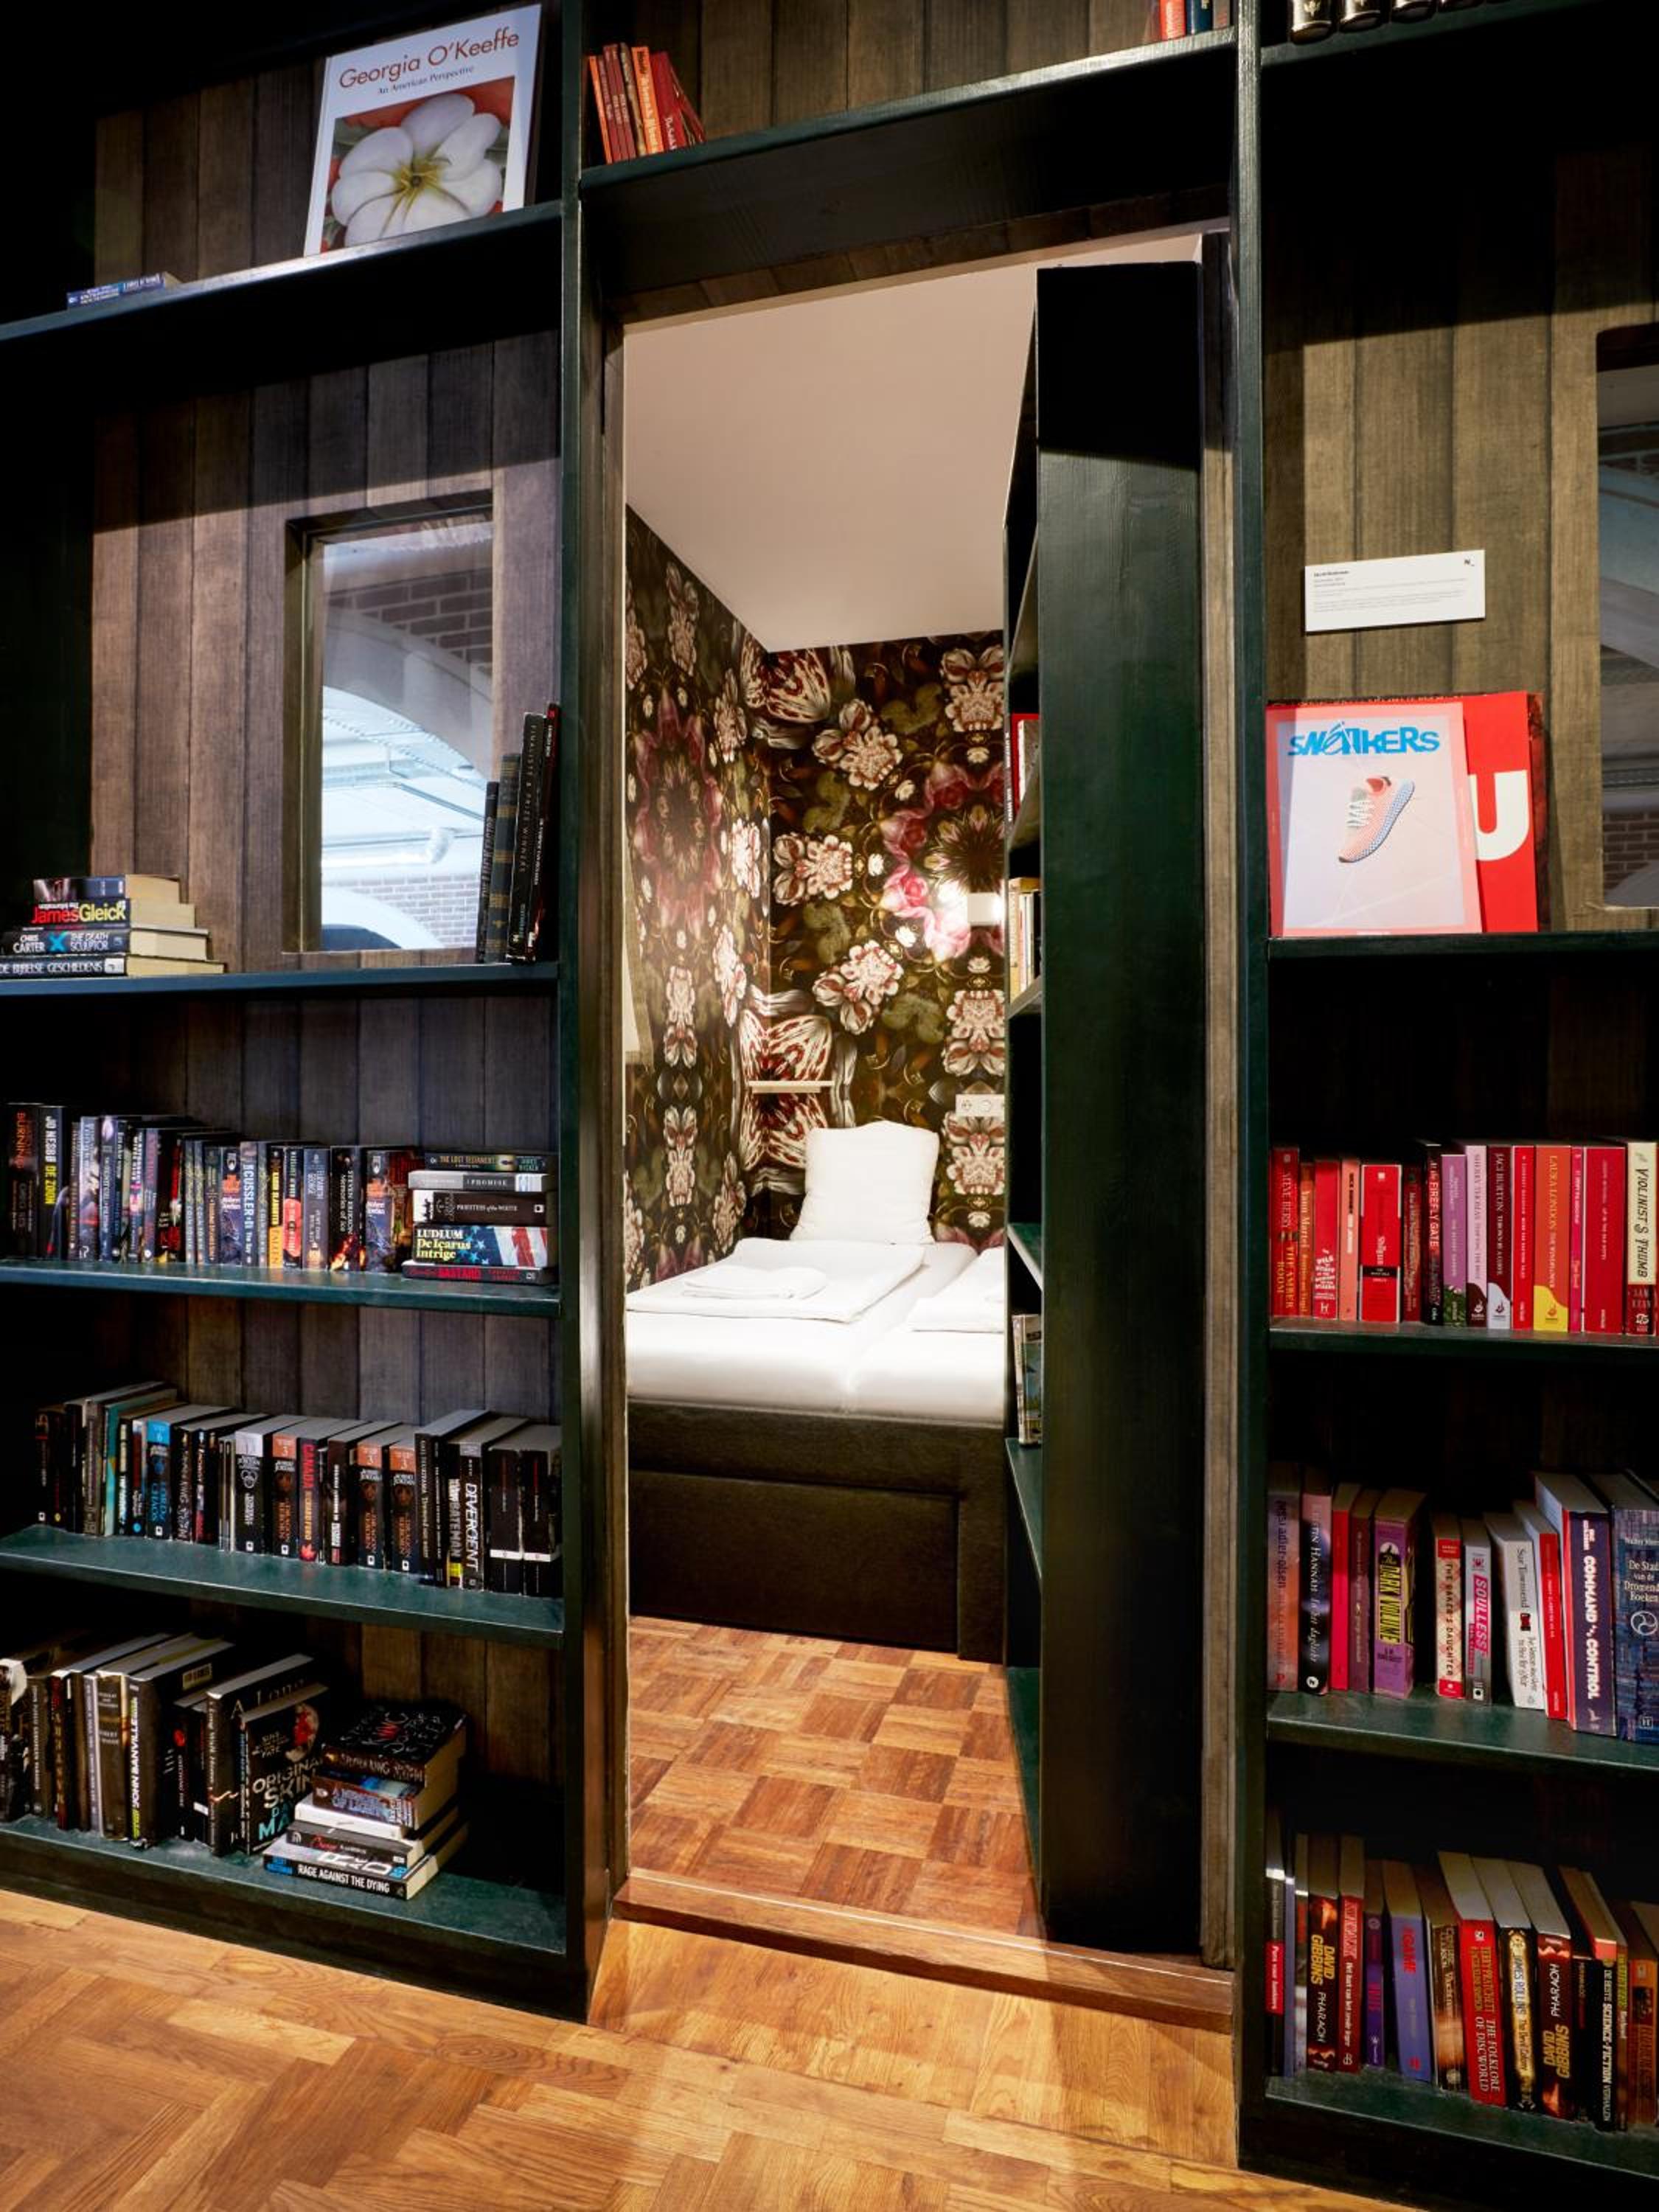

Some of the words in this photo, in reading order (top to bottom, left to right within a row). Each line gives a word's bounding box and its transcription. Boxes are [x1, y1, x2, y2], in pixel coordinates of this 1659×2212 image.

[339, 55, 420, 88] Georgia
[428, 27, 520, 66] O'Keeffe
[392, 78, 428, 92] American
[429, 66, 475, 83] Perspective
[31, 905, 80, 924] James
[80, 901, 127, 922] Gleick
[13, 942, 45, 953] CARTER
[21, 935, 39, 943] CHRIS
[71, 933, 84, 942] THE
[86, 933, 108, 942] DEATH
[71, 941, 109, 951] SCULPTOR
[45, 1116, 57, 1129] JO
[45, 1164, 57, 1178] DE
[1548, 1156, 1558, 1188] LAURA
[45, 1179, 57, 1204] ZOON
[243, 1171, 254, 1216] CUSSLER
[1301, 1190, 1310, 1213] Yann
[1429, 1182, 1439, 1220] FIREFLY
[1495, 1175, 1505, 1211] BURTON
[340, 1211, 347, 1220] of
[1548, 1189, 1558, 1229] LONDON
[417, 1229, 464, 1239] LUDLUM
[417, 1239, 433, 1249] De
[434, 1239, 472, 1251] Icarus
[1301, 1215, 1310, 1248] Martel
[1429, 1222, 1439, 1247] GATE
[417, 1248, 456, 1260] Intrige
[1276, 1262, 1285, 1294] ROOM
[1286, 1271, 1295, 1308] AMBER
[302, 1444, 314, 1488] CANADA
[449, 1501, 462, 1557] BATEMAN
[465, 1483, 479, 1573] DIVERGENT
[1277, 1528, 1288, 1589] adler-olsen
[1310, 1547, 1322, 1593] HANNAH
[1516, 1548, 1527, 1564] Sue
[1629, 1559, 1640, 1570] De
[1379, 1565, 1402, 1594] DARK
[1518, 1566, 1531, 1608] Townsend
[1583, 1555, 1597, 1623] COMMAND
[1379, 1598, 1402, 1644] VOLUME
[1475, 1578, 1488, 1652] SOULLESS
[1446, 1627, 1454, 1676] DAUGHTER
[1586, 1638, 1601, 1700] CONTROL
[130, 1719, 139, 1775] BANVILLE
[298, 1864, 318, 1877] RAGE
[319, 1867, 350, 1885] AGAINST
[350, 1875, 365, 1888] THE
[366, 1879, 391, 1893] DYING
[1310, 1934, 1324, 1986] GIBBINS
[1324, 1946, 1335, 1980] DAVID
[1512, 1954, 1523, 1979] JAMES
[1514, 1981, 1525, 2016] ROLLINS
[1548, 1963, 1561, 2017] PHARAOH
[1316, 1992, 1329, 2043] PHARAOH
[1475, 2017, 1485, 2031] OF
[1486, 2018, 1497, 2039] THE
[1518, 2020, 1527, 2030] The
[1519, 2031, 1528, 2047] Devil
[1543, 2030, 1557, 2067] DAVID
[1554, 2023, 1570, 2079] GIBBINS
[1601, 2003, 1613, 2084] SCIENCE-FICTION
[1476, 2032, 1488, 2092] DISCWORLD
[1488, 2041, 1500, 2093] FOLKLORE
[1518, 2048, 1529, 2071] Colony
